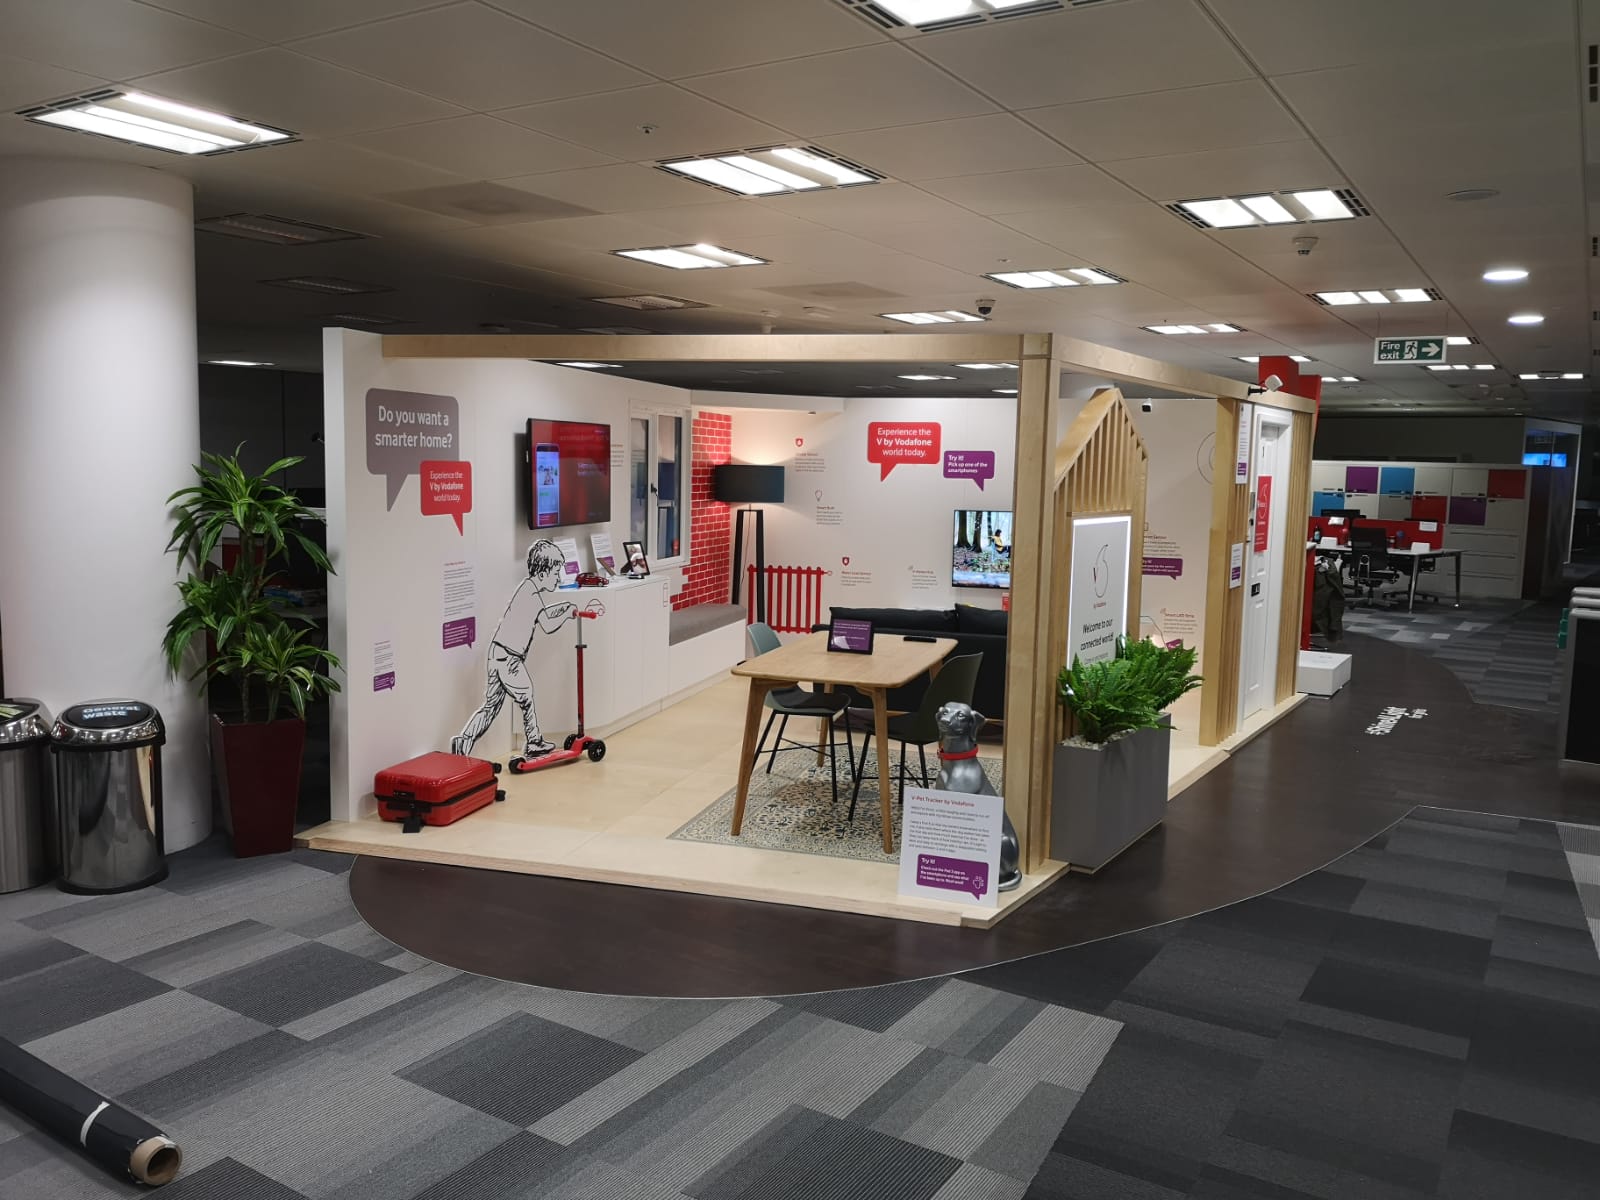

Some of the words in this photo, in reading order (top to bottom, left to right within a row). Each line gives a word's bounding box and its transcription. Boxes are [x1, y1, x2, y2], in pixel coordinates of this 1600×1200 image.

[1381, 342, 1400, 350] Fire
[1380, 352, 1400, 360] exit
[378, 406, 393, 422] Do
[396, 410, 414, 426] you
[417, 412, 441, 426] want
[443, 414, 449, 426] a
[877, 428, 917, 438] Experience
[918, 428, 931, 436] the
[375, 432, 417, 448] smarter
[420, 432, 452, 448] home?
[884, 438, 893, 448] by
[894, 438, 932, 446] Vodafone
[882, 448, 903, 456] world
[904, 448, 926, 458] today.
[430, 470, 454, 480] Experience
[442, 482, 464, 491] Vodafone
[1083, 622, 1101, 634] Welcome
[1080, 635, 1101, 650] connected
